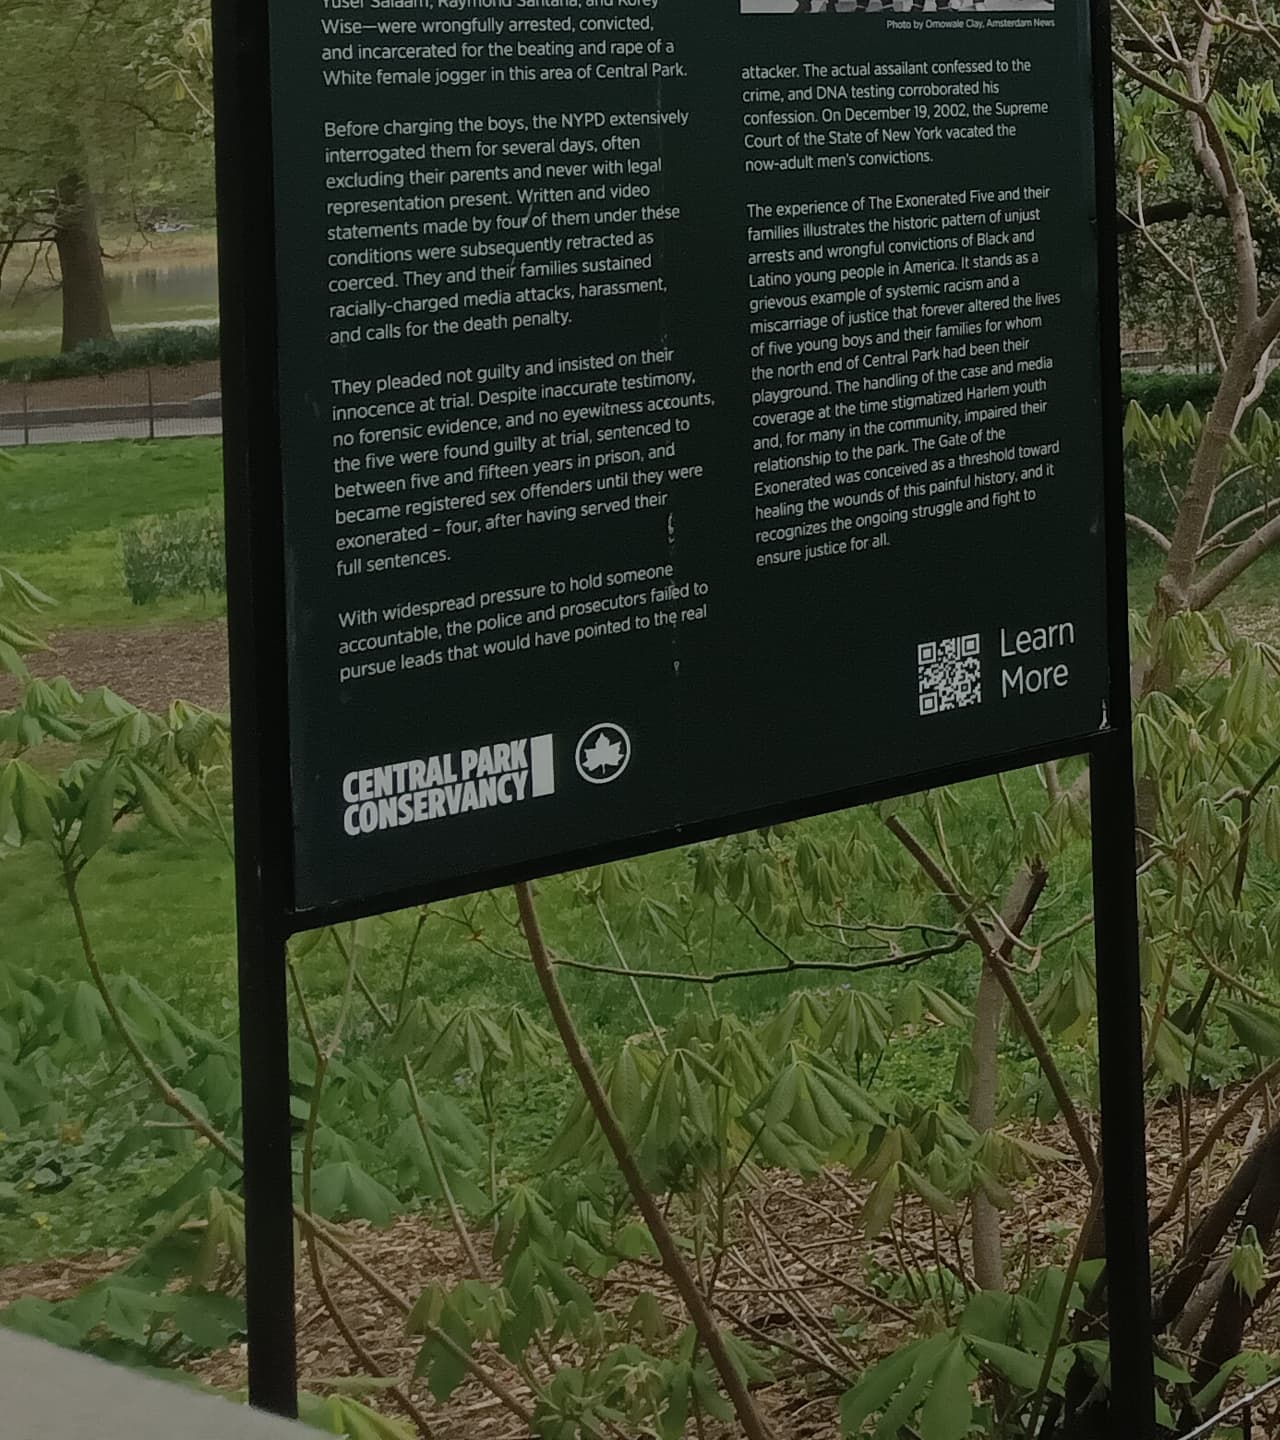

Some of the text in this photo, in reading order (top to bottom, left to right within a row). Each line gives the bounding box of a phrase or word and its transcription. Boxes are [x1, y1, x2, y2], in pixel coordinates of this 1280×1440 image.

[886, 19, 911, 29] Photo
[913, 19, 923, 30] by
[986, 18, 1033, 28] Amsterdam
[1033, 17, 1056, 27] News
[741, 58, 1031, 79] attacker. The actual assailant confessed to the
[324, 109, 689, 137] Before charging the boys, the NYPD extensively
[743, 102, 1048, 126] confession. On December 19, 2002, the Supreme
[326, 157, 662, 189] excluding their parents and never with legal
[746, 185, 1051, 218] The experience of The Exonerated Five and their
[749, 274, 1020, 314] grievous example of systemic racism and a
[330, 309, 572, 347] and calls for the death penalty.
[331, 346, 675, 396] They pleaded not guilty and insisted on their
[756, 532, 891, 566] ensure justice for all.
[338, 564, 673, 628] With widespread pressure to hold someone
[1000, 622, 1074, 657] Learn
[1001, 663, 1069, 698] More
[342, 739, 529, 803] CENTRAL PARK
[343, 770, 529, 836] CONSERVANCY
